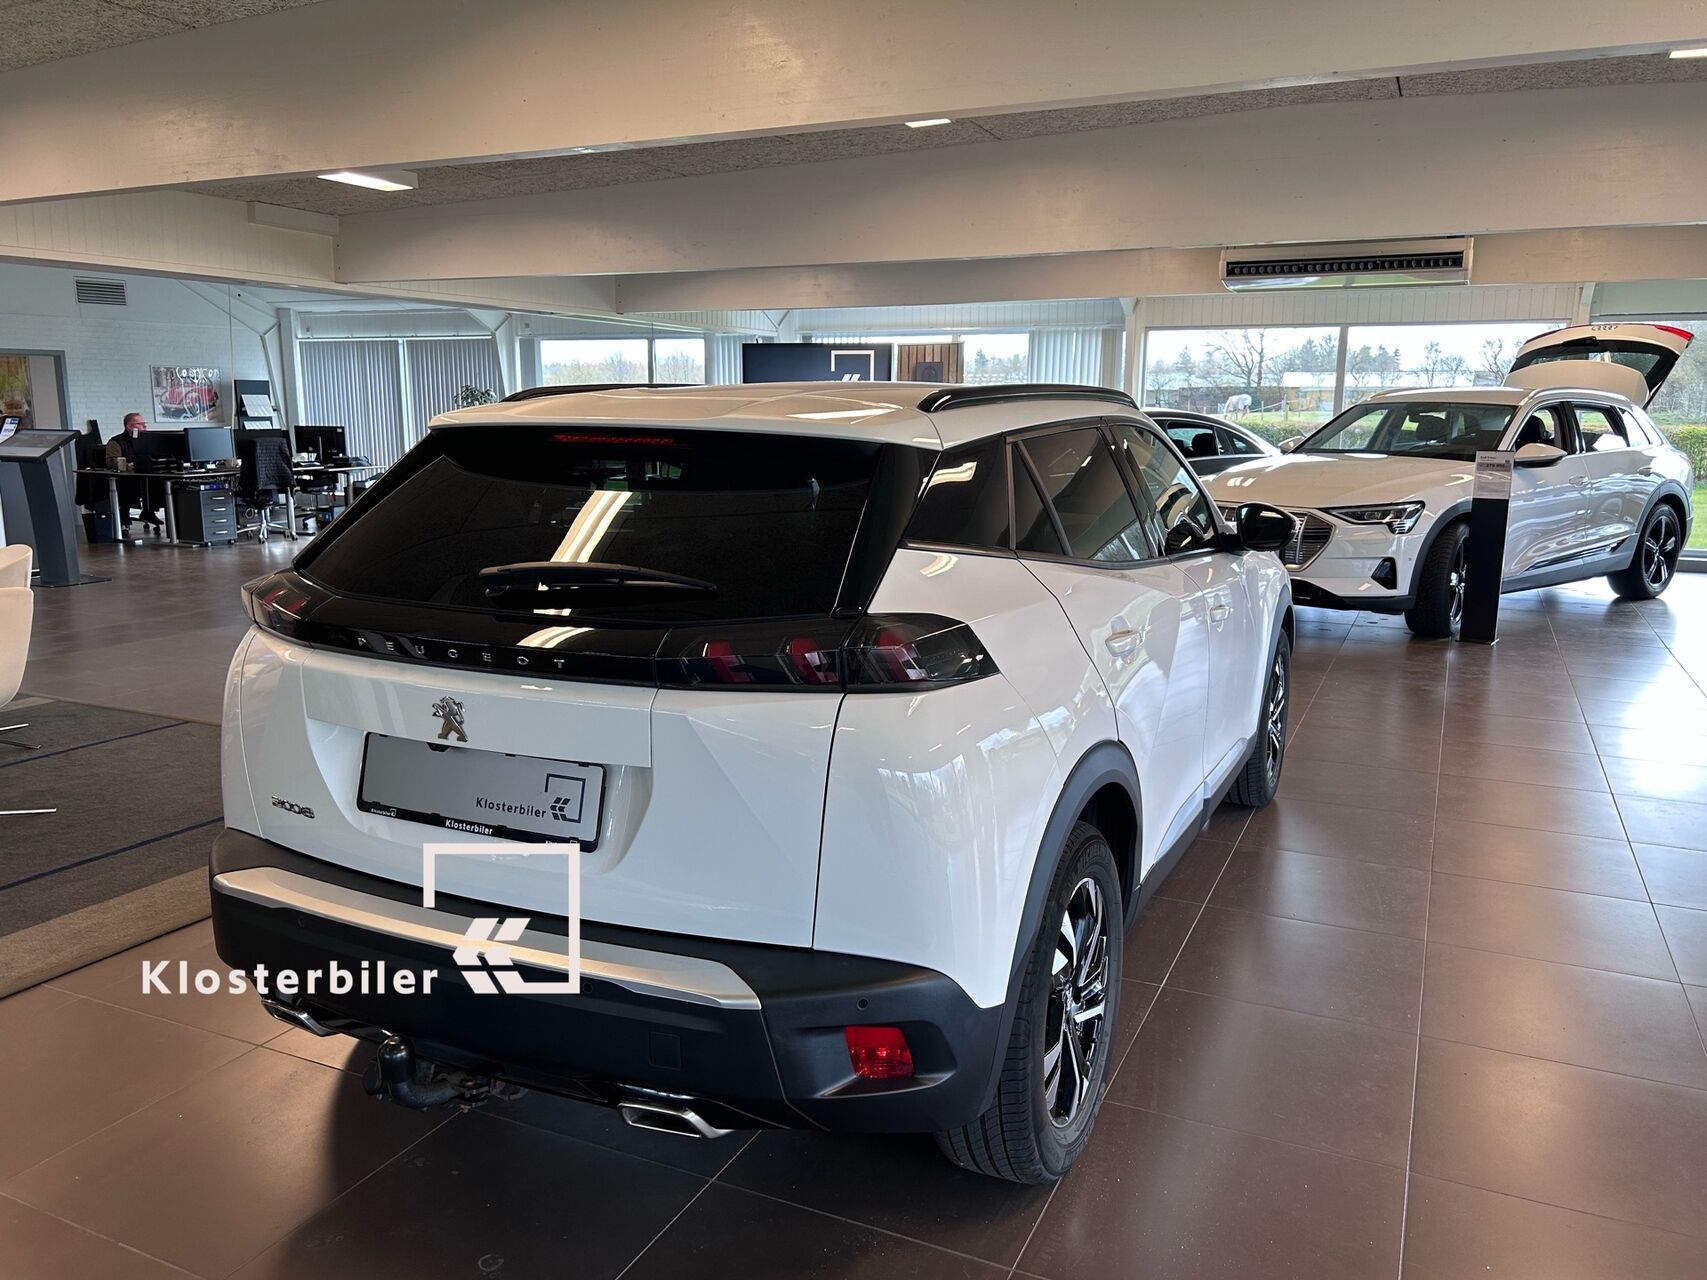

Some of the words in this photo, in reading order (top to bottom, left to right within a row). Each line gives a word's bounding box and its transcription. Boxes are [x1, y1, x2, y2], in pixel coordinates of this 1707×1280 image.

[358, 637, 565, 669] PEUGEOT
[475, 796, 546, 819] Klosterbiler
[445, 818, 493, 836] Klosterbiler
